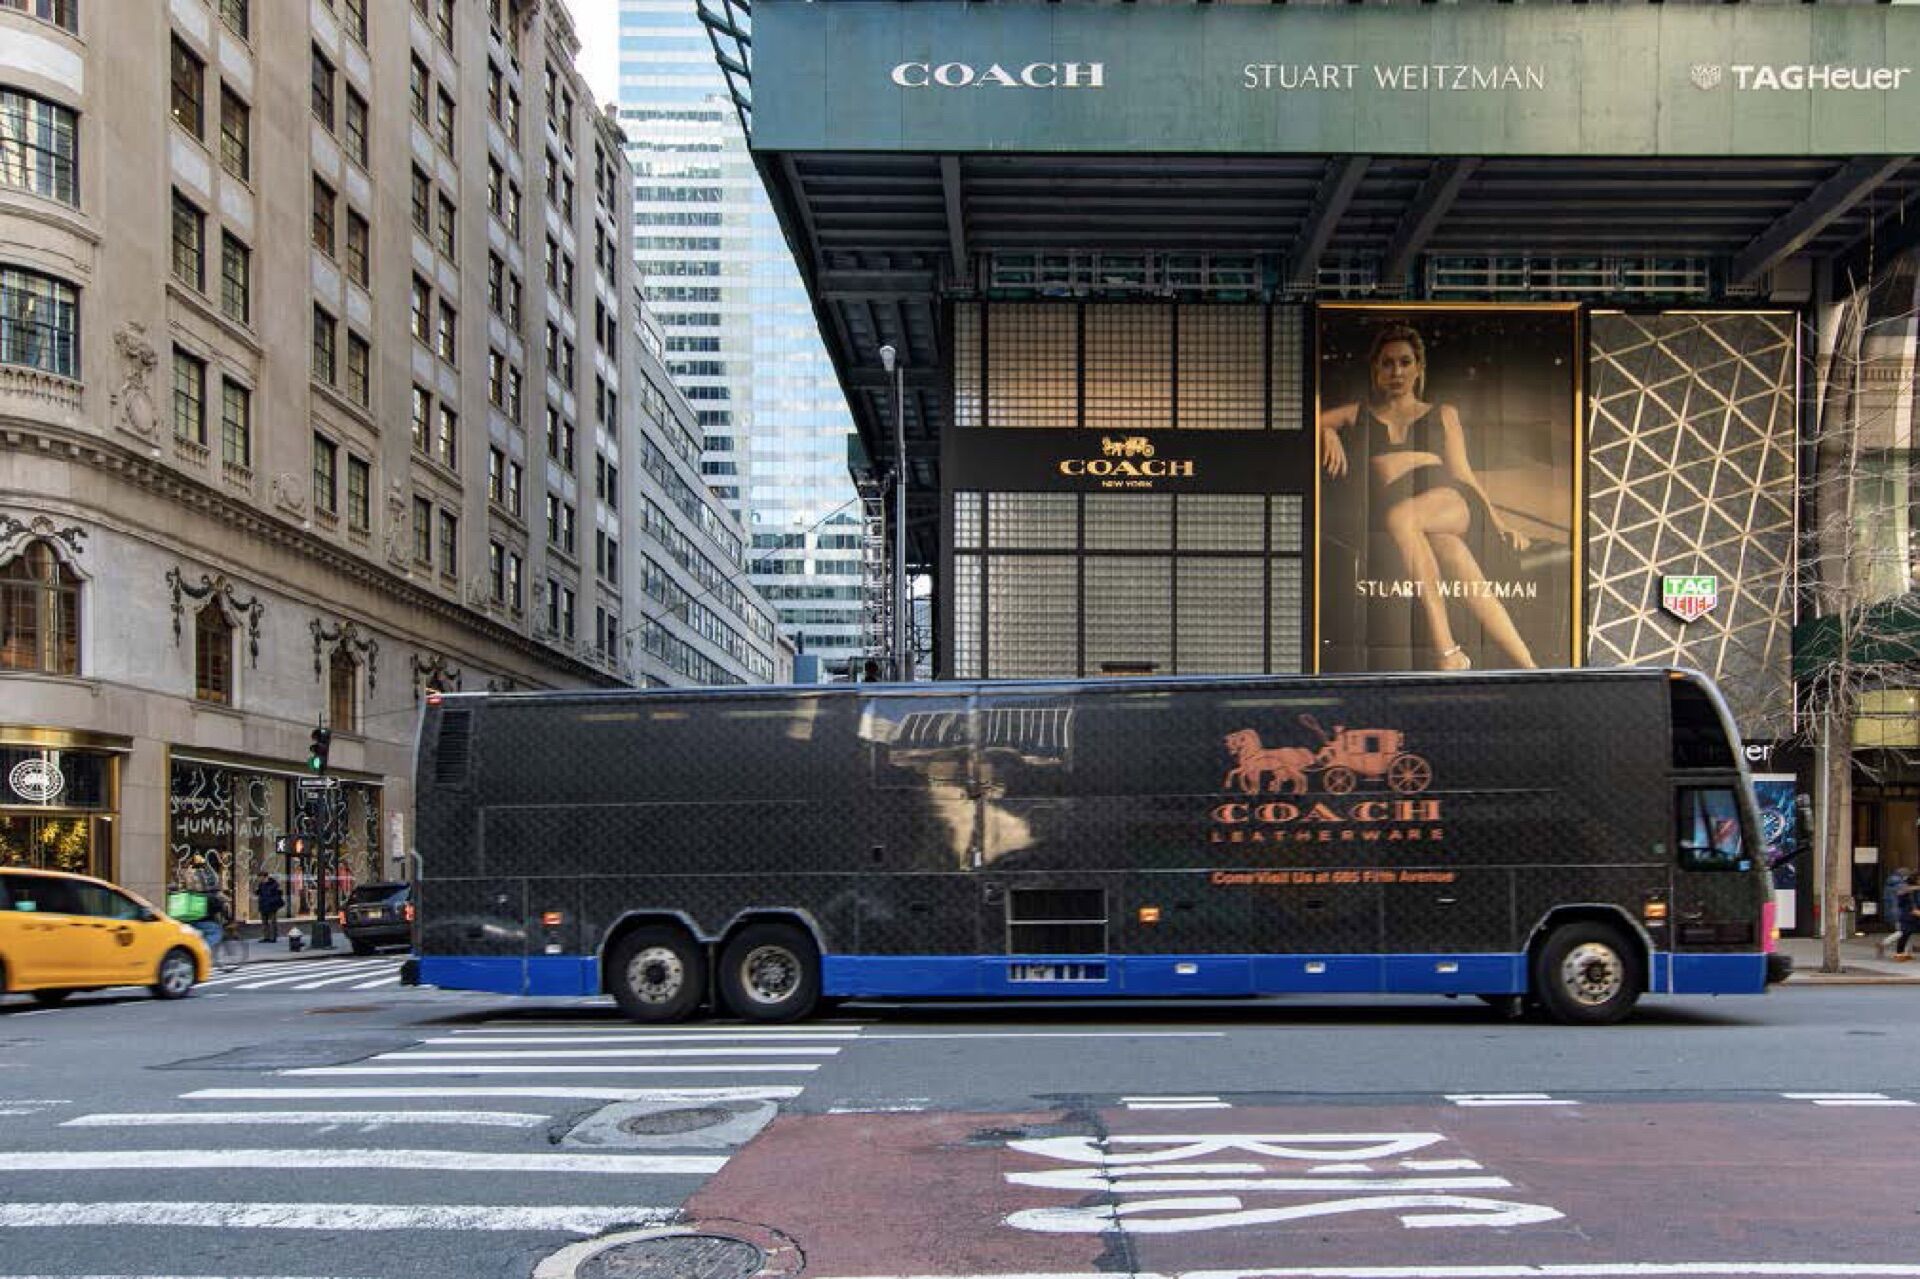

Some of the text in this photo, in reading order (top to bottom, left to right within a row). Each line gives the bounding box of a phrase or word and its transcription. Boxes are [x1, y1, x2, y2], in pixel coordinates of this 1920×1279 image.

[891, 62, 1105, 88] COACH
[1243, 63, 1545, 90] STUART WEITZMAN
[1058, 459, 1196, 477] COACH
[1101, 479, 1153, 488] NEW YORK
[1436, 580, 1537, 598] WEITZMAN
[1667, 578, 1713, 594] TAG
[1741, 744, 1774, 761] er
[1210, 800, 1442, 823] COACH
[1210, 828, 1444, 842] LEATHERWARE
